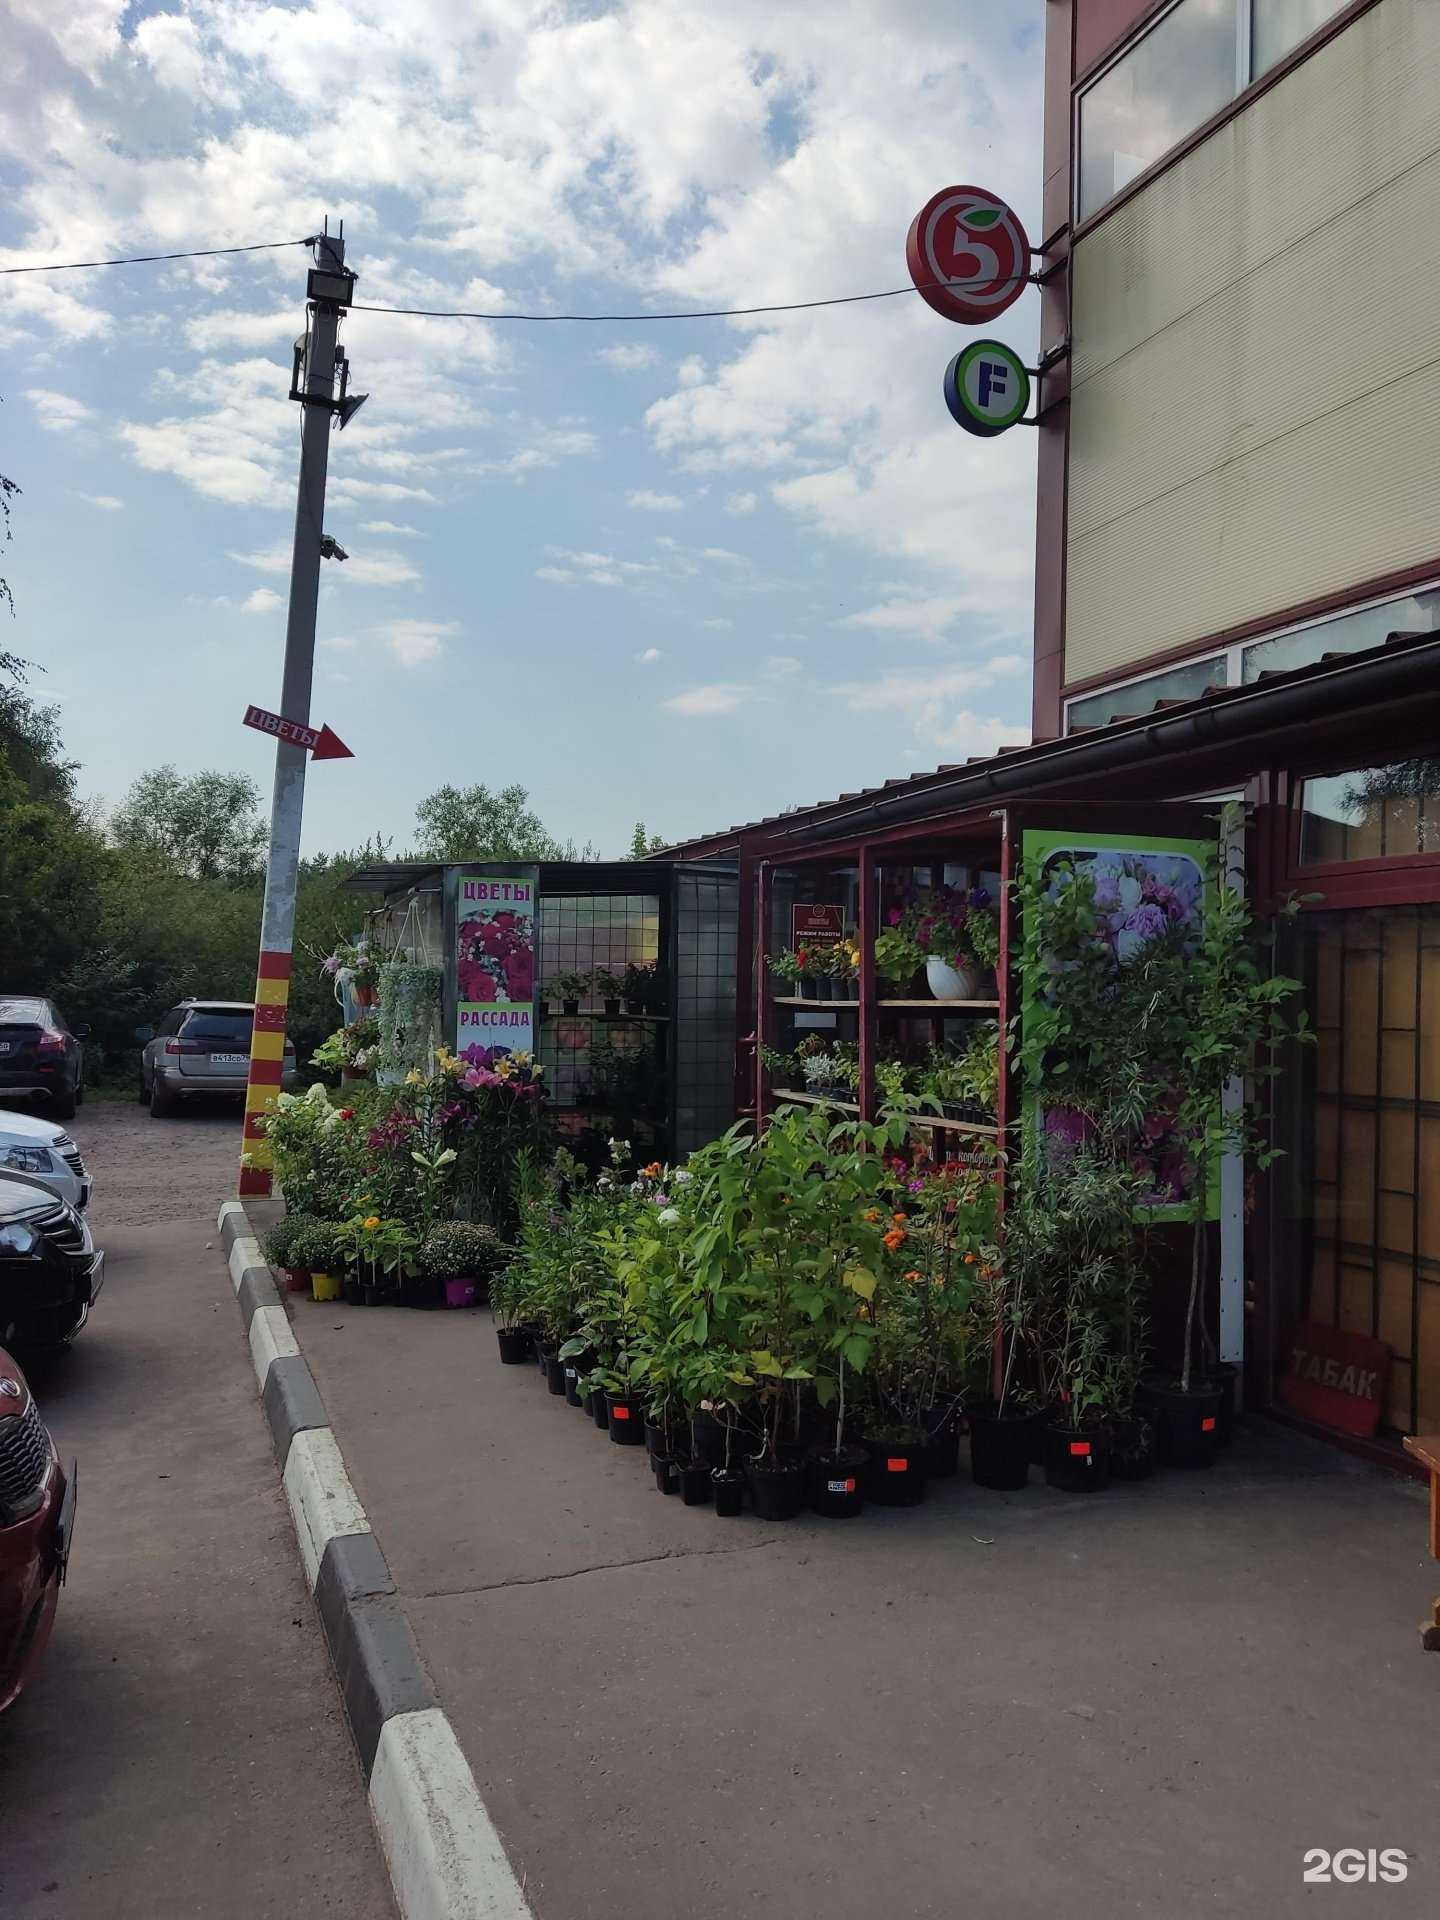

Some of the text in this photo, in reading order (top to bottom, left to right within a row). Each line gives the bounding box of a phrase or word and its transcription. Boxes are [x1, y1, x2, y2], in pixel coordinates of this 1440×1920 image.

[978, 361, 1008, 408] F
[248, 709, 321, 748] ЦВЕТЫ
[463, 881, 531, 901] ЦВЕТЫ
[459, 1010, 531, 1028] РАССАДА
[1291, 1346, 1378, 1401] ТАБАК
